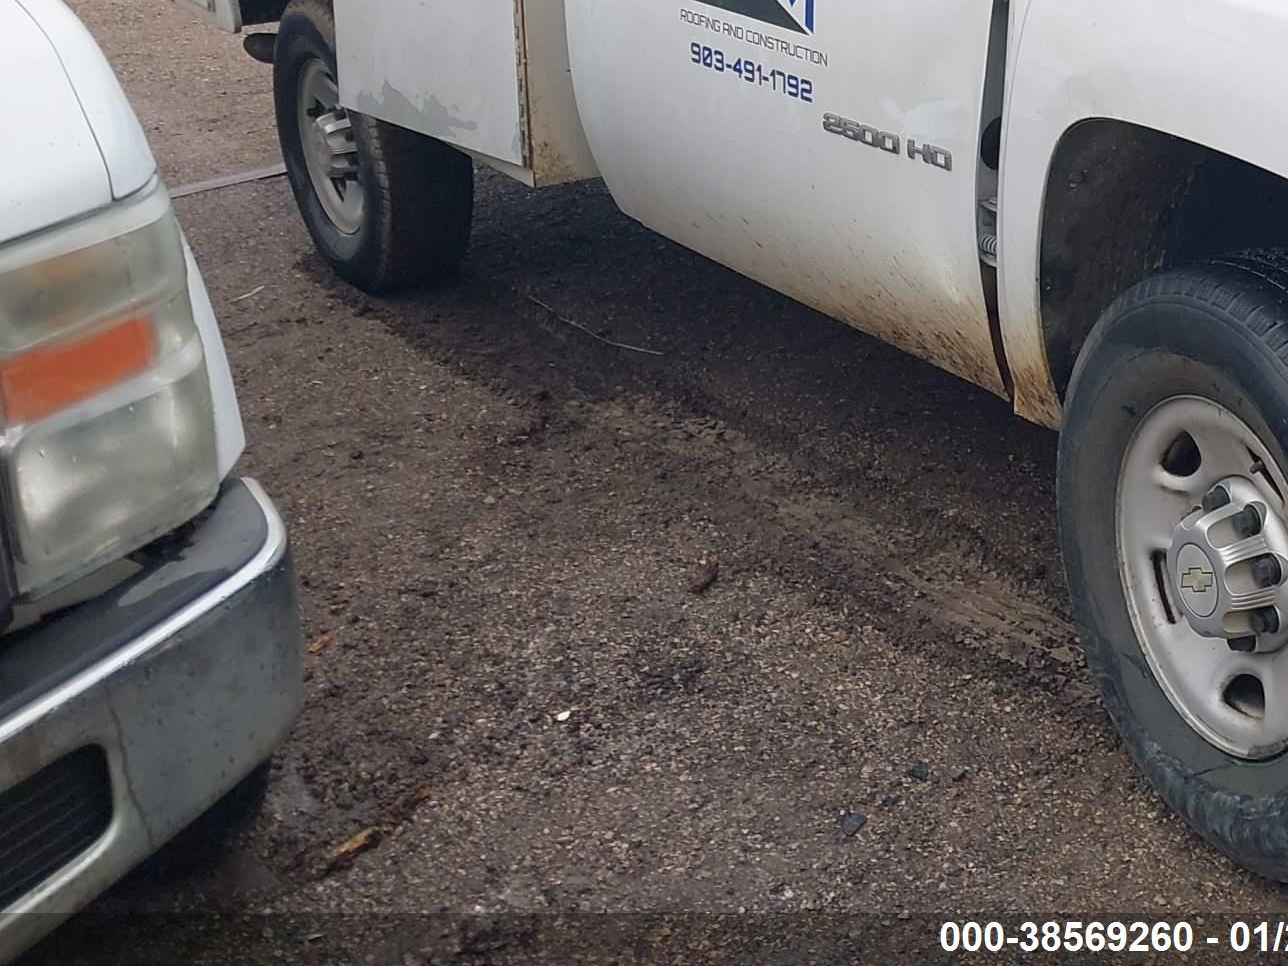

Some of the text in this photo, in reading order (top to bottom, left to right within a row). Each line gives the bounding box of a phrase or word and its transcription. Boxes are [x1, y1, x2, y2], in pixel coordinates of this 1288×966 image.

[680, 8, 828, 67] ROOFING AND CONSTRUCTION
[690, 42, 813, 103] 903-491-1792
[822, 112, 952, 171] 2500 HD
